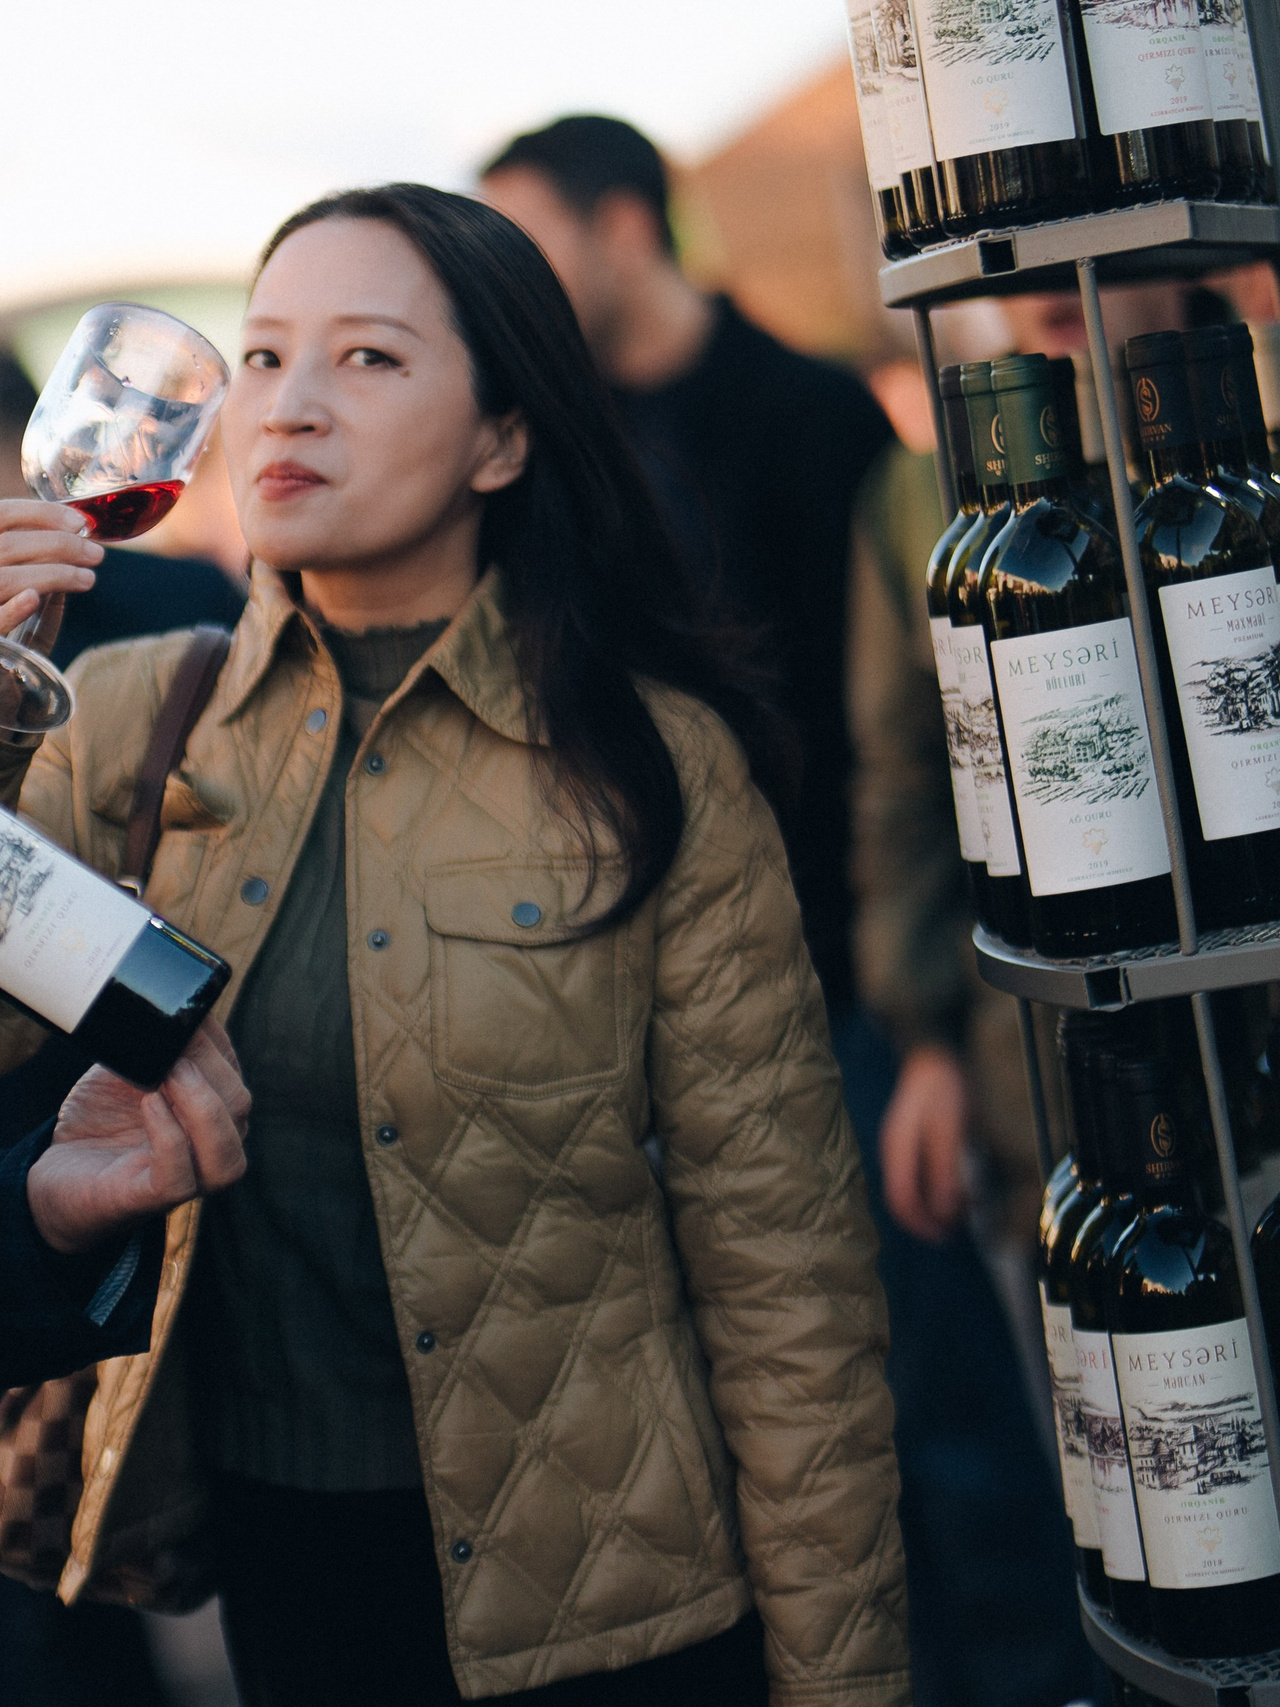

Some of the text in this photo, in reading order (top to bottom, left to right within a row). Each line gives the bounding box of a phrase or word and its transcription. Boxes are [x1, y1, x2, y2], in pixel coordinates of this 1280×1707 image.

[1204, 49, 1231, 57] IRMIZI
[986, 72, 1014, 84] QURU
[1008, 637, 1119, 677] MEYSƏRİ
[1250, 737, 1280, 752] ORQAN
[1084, 810, 1112, 823] QURU
[1128, 1338, 1238, 1372] MEYSƏRİ
[1163, 1373, 1206, 1390] MƏRCAN
[1164, 1507, 1248, 1524] QIRMIZI QURU
